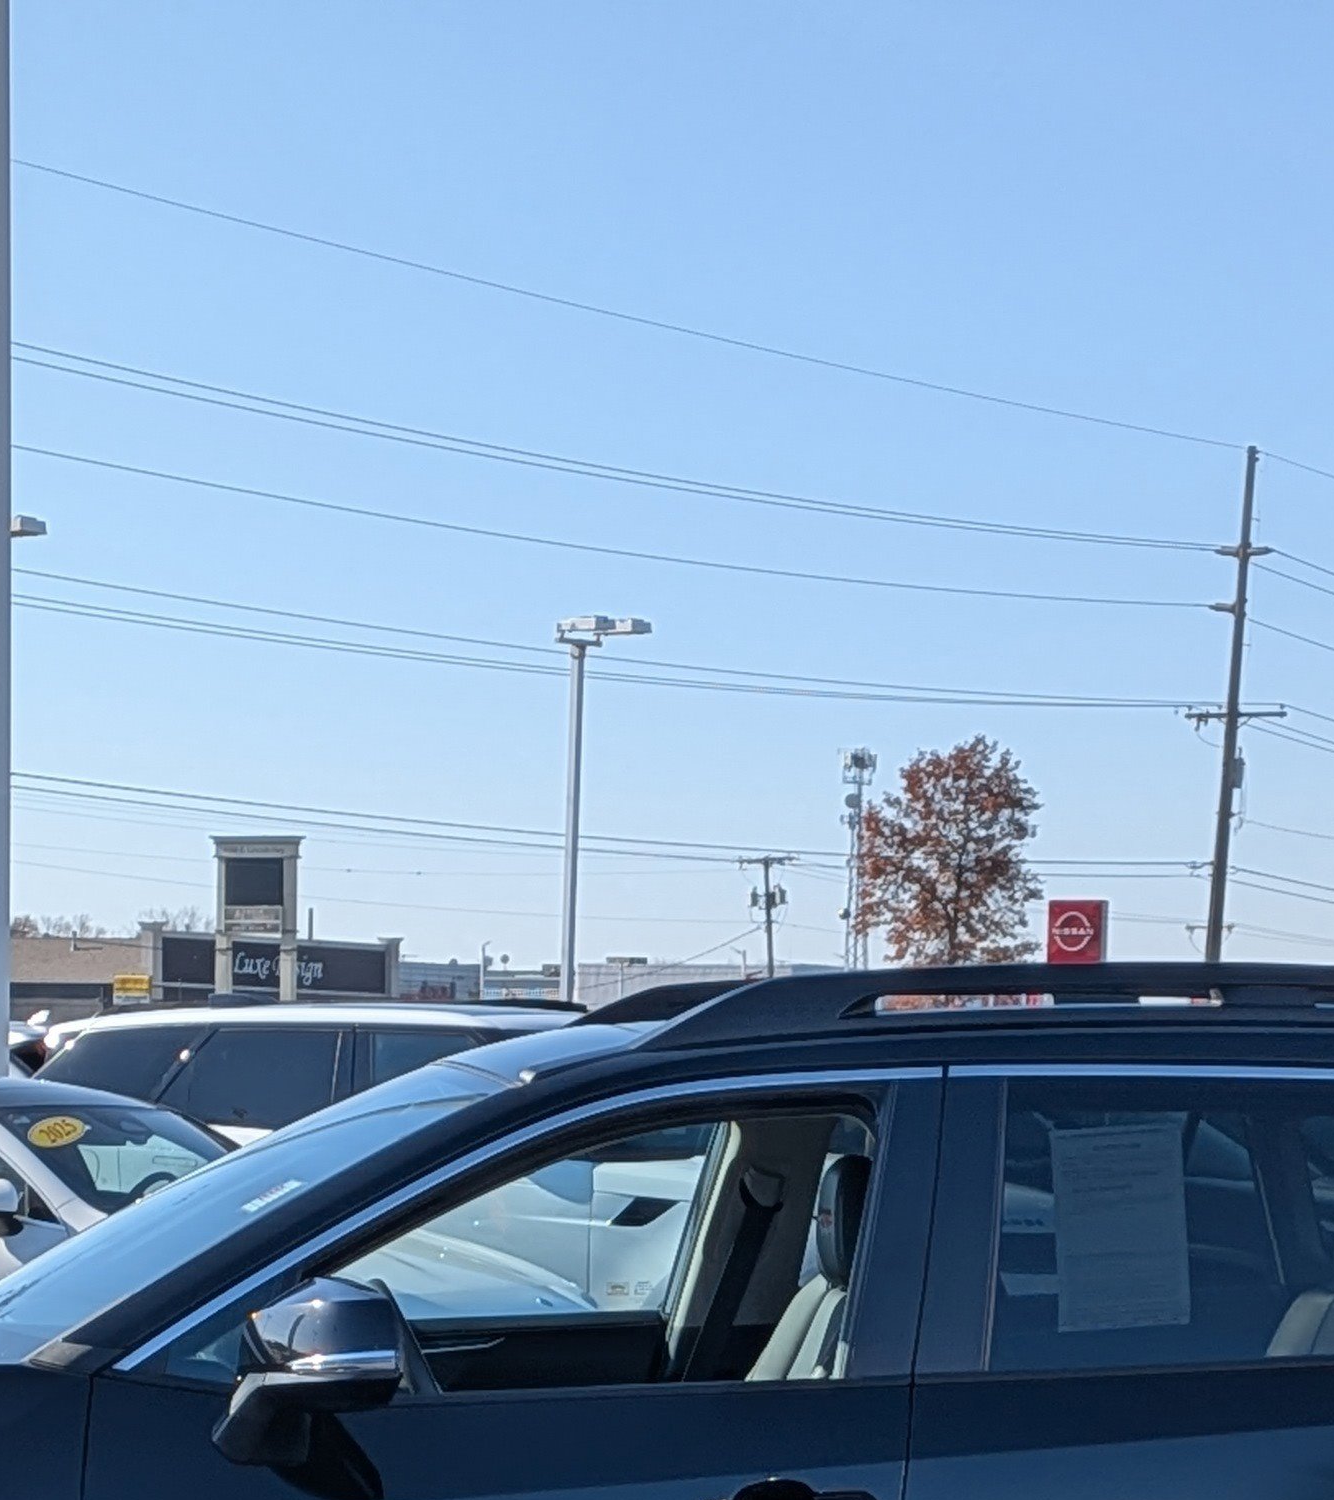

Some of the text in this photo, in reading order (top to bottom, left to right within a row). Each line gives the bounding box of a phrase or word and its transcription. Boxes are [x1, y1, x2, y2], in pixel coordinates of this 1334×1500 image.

[1052, 927, 1094, 935] NISSAN
[234, 952, 324, 985] Luxe Dsign
